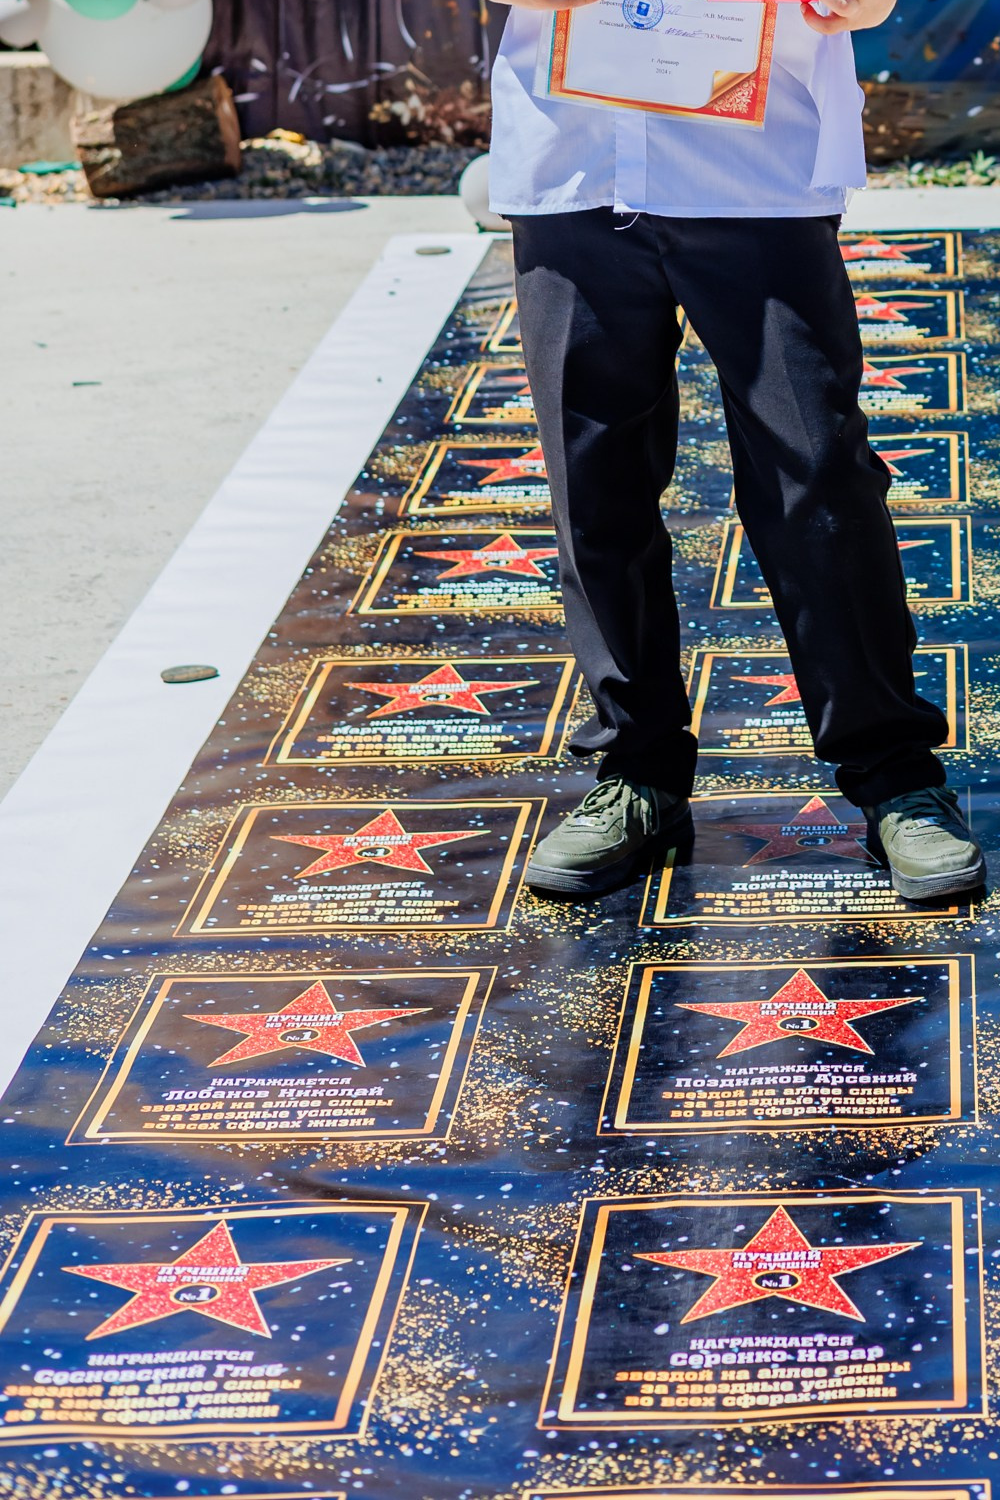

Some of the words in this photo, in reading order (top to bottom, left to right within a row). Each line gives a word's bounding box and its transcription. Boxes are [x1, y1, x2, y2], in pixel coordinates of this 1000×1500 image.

[675, 1075, 806, 1087] Поздняков
[814, 1072, 917, 1085] Арсений
[166, 1088, 269, 1100] Лобанов
[278, 1086, 384, 1098] Николай
[669, 1351, 787, 1368] Серенко
[797, 1346, 884, 1363] Назар
[615, 1369, 713, 1382] звездой
[721, 1368, 749, 1381] на
[757, 1366, 827, 1379] аллее
[835, 1362, 911, 1375] славы
[640, 1383, 668, 1395] за
[676, 1380, 794, 1394] звездные
[800, 1374, 883, 1392] успехи
[625, 1395, 653, 1407] во
[660, 1396, 715, 1407] всех
[722, 1392, 810, 1409] сферах
[818, 1387, 897, 1401] жизни
